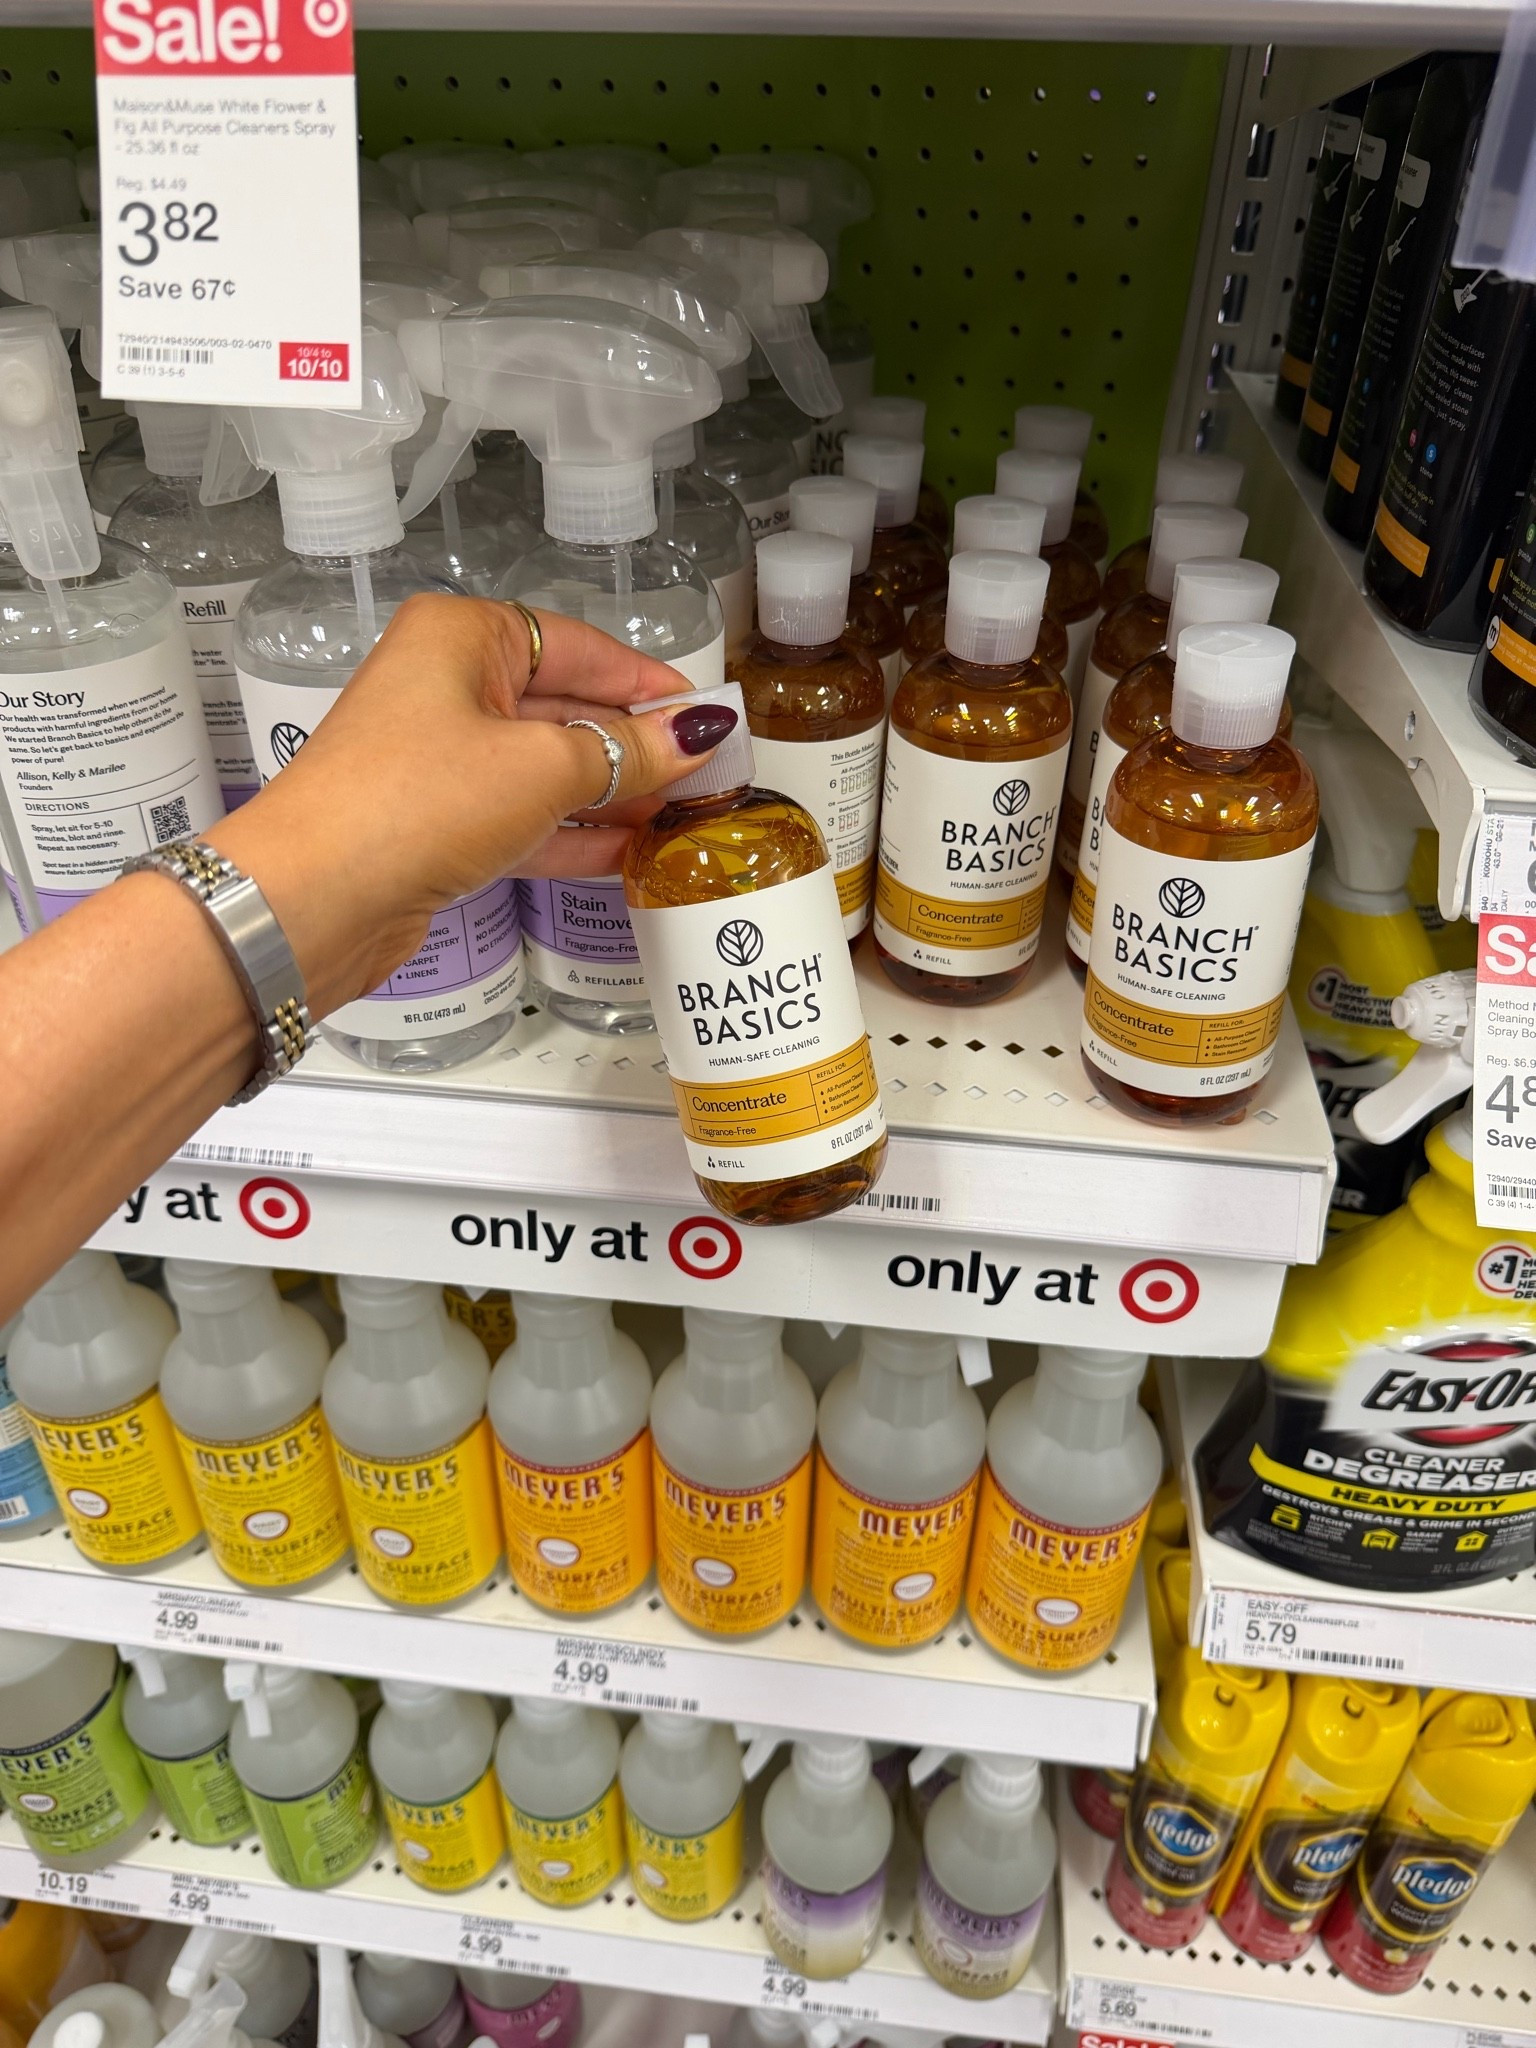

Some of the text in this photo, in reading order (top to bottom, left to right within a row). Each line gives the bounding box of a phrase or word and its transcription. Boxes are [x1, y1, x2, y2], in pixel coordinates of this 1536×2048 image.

[103, 0, 282, 64] Sale!
[113, 99, 326, 114] Maison&Muse White Flower &
[114, 119, 336, 138] Fig All Purpose Cleaners Spray
[126, 140, 165, 155] 25.36
[183, 143, 199, 155] oz
[116, 177, 187, 192] Reg. $4.49
[118, 275, 236, 301] Save 67¢
[296, 346, 332, 358] 10/4 to
[287, 358, 344, 379] 10/10
[183, 600, 227, 617] Refill
[0, 691, 85, 708] Our Story
[0, 714, 13, 722] Our
[56, 706, 107, 720] transformed
[108, 702, 128, 712] when
[54, 721, 87, 731] harmful
[87, 712, 131, 727] ingredients
[131, 706, 149, 717] from
[149, 702, 160, 710] our
[18, 735, 46, 743] started
[47, 733, 76, 742] Branch
[76, 728, 103, 740] Basics
[104, 727, 113, 735] to
[113, 723, 131, 733] help
[131, 716, 153, 728] others
[153, 711, 162, 720] do
[162, 707, 172, 716] the
[60, 745, 74, 754] get
[74, 741, 94, 750] back
[95, 740, 104, 748] to
[104, 734, 130, 746] basics
[130, 729, 144, 739] and
[144, 716, 176, 734] experience
[44, 756, 65, 765] pure!
[16, 763, 126, 782] Allison, Kelly & Marilee
[19, 782, 53, 791] Founders
[25, 801, 90, 812] DIRECTIONS
[31, 824, 55, 833] Spray,
[80, 823, 92, 831] for
[35, 834, 68, 842] minutes,
[86, 832, 102, 840] and
[103, 829, 126, 838] rinse.
[941, 808, 1057, 848] BRANCH
[37, 843, 64, 852] Repeat
[76, 840, 120, 850] necessary.
[946, 837, 1047, 873] BASICS
[950, 870, 1038, 890] HUMAN-SAFE CLEANING
[560, 891, 607, 913] Stain
[917, 904, 1004, 924] Concentrate
[915, 925, 972, 943] Fragrance-Free
[1112, 903, 1254, 954] BRANCH
[926, 954, 952, 965] REFILL
[1114, 936, 1239, 983] BASICS
[406, 967, 439, 980] LINENS
[585, 976, 645, 986] REFILLABLE
[677, 954, 822, 1013] BRANCH
[1117, 973, 1226, 1001] HUMAN-SAFE CLEANING
[403, 1002, 466, 1024] 16 FL OZ (473 mL)
[1094, 991, 1174, 1037] Concentrate
[1488, 998, 1530, 1011] Method
[692, 992, 821, 1046] BASICS
[1487, 1011, 1535, 1027] Cleaning
[1091, 1013, 1137, 1049] Fragrance-Free
[1487, 1025, 1519, 1039] Spray
[709, 1035, 820, 1067] HUMAN-SAFE CLEANING
[1096, 1048, 1118, 1067] REFILL
[1486, 1055, 1511, 1069] Reg.
[816, 1068, 834, 1079] REFILL
[692, 1092, 787, 1113] Concentrate
[699, 1125, 757, 1144] Fragrance-Free
[831, 1139, 836, 1149] 8
[836, 1136, 844, 1148] FL
[844, 1131, 854, 1144] OZ
[853, 1125, 864, 1141] (237
[1486, 1128, 1536, 1150] Save
[718, 1159, 745, 1168] REFILL
[164, 1182, 222, 1223] at
[451, 1209, 650, 1264] only at
[887, 1250, 1099, 1306] only at
[1488, 1254, 1518, 1284] #1
[1361, 1367, 1536, 1412] EASY-OF
[195, 1415, 323, 1474] MEYER'S
[1303, 1448, 1536, 1493] DEGREASER
[1365, 1448, 1505, 1473] CLEANER
[503, 1458, 624, 1501] MEYER'S
[664, 1475, 787, 1524] MEYER'S
[1262, 1484, 1481, 1529] DESTROYS GREASE & GRIME IN
[1331, 1486, 1507, 1513] HEAVY DUTY
[1009, 1517, 1139, 1564] MEYER'S
[1247, 1600, 1308, 1614] EASY-OFF
[157, 1609, 198, 1630] 4.99
[1245, 1621, 1296, 1645] 5.79
[555, 1659, 608, 1685] 4.99
[38, 1873, 87, 1893] 10.19
[168, 1891, 210, 1912] 4.99
[459, 1931, 502, 1955] 4.99
[762, 1978, 806, 1998] 4.99
